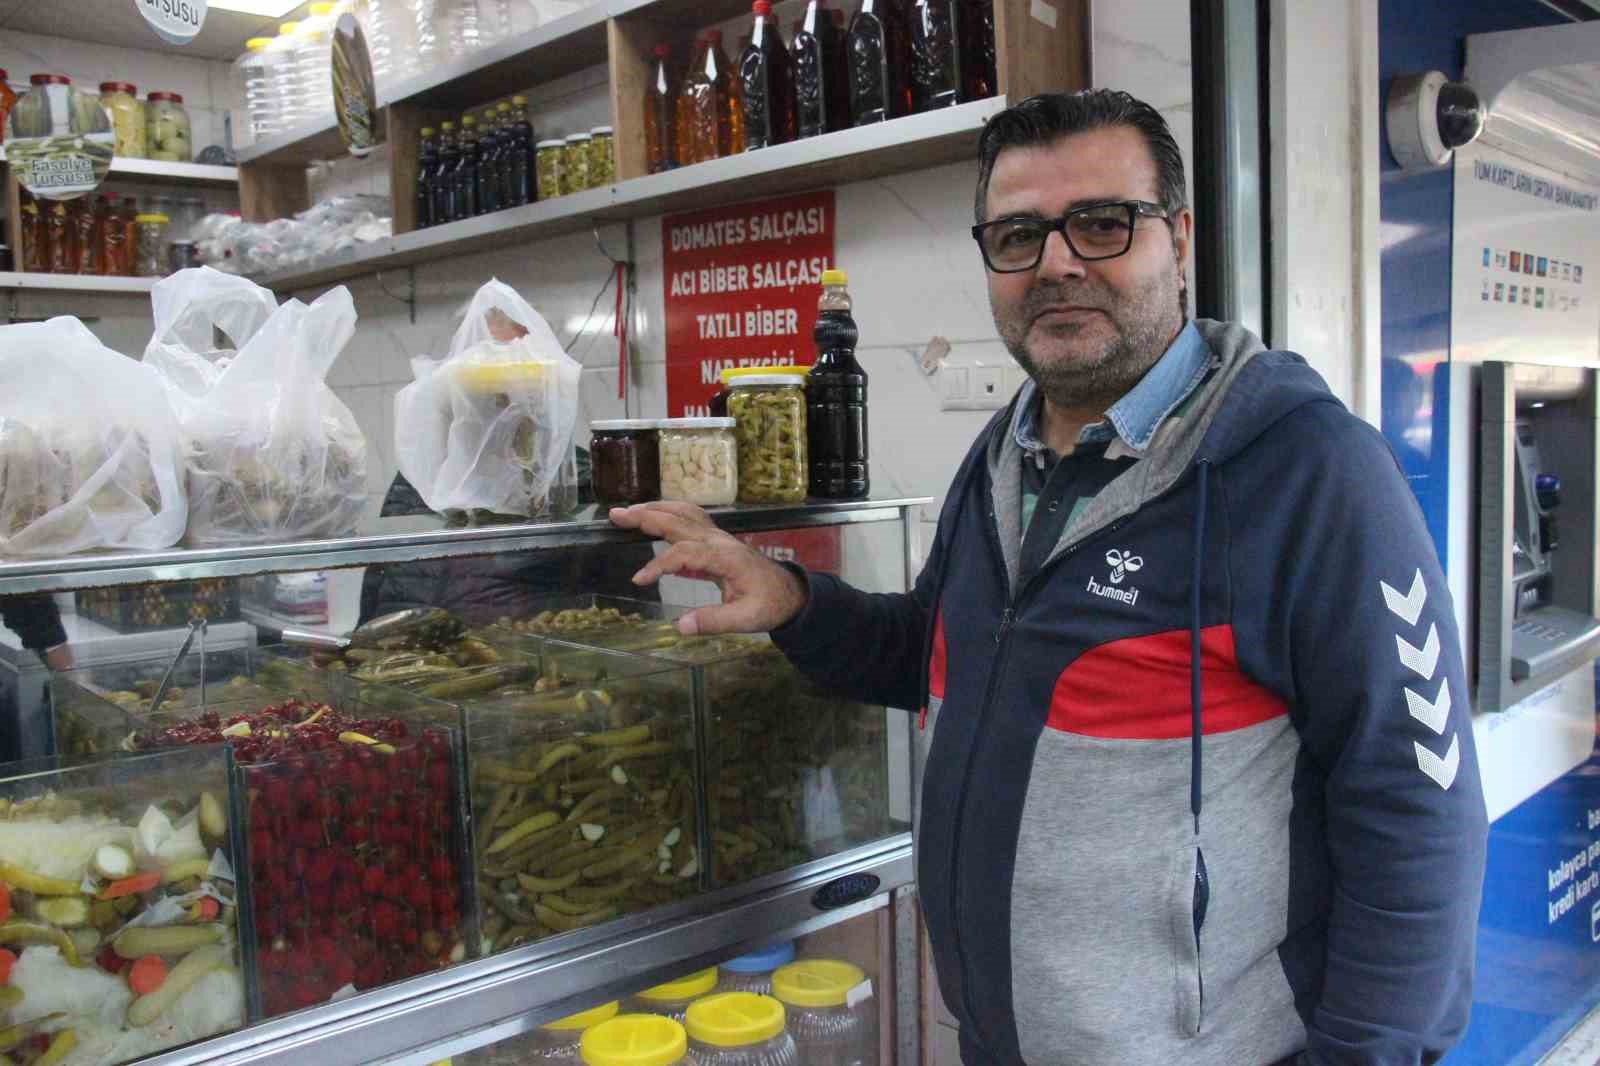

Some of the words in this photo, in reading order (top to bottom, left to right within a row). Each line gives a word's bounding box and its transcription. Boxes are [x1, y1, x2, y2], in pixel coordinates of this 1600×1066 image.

[671, 218, 746, 252] DOMATES
[750, 207, 825, 244] SALÇASI
[671, 270, 696, 297] ACI
[700, 261, 749, 294] BİBER
[697, 312, 741, 339] TATLI
[745, 304, 798, 336] BİBER
[1086, 575, 1140, 606] hummel
[1548, 849, 1587, 892] kolayca
[1548, 883, 1575, 924] kredi
